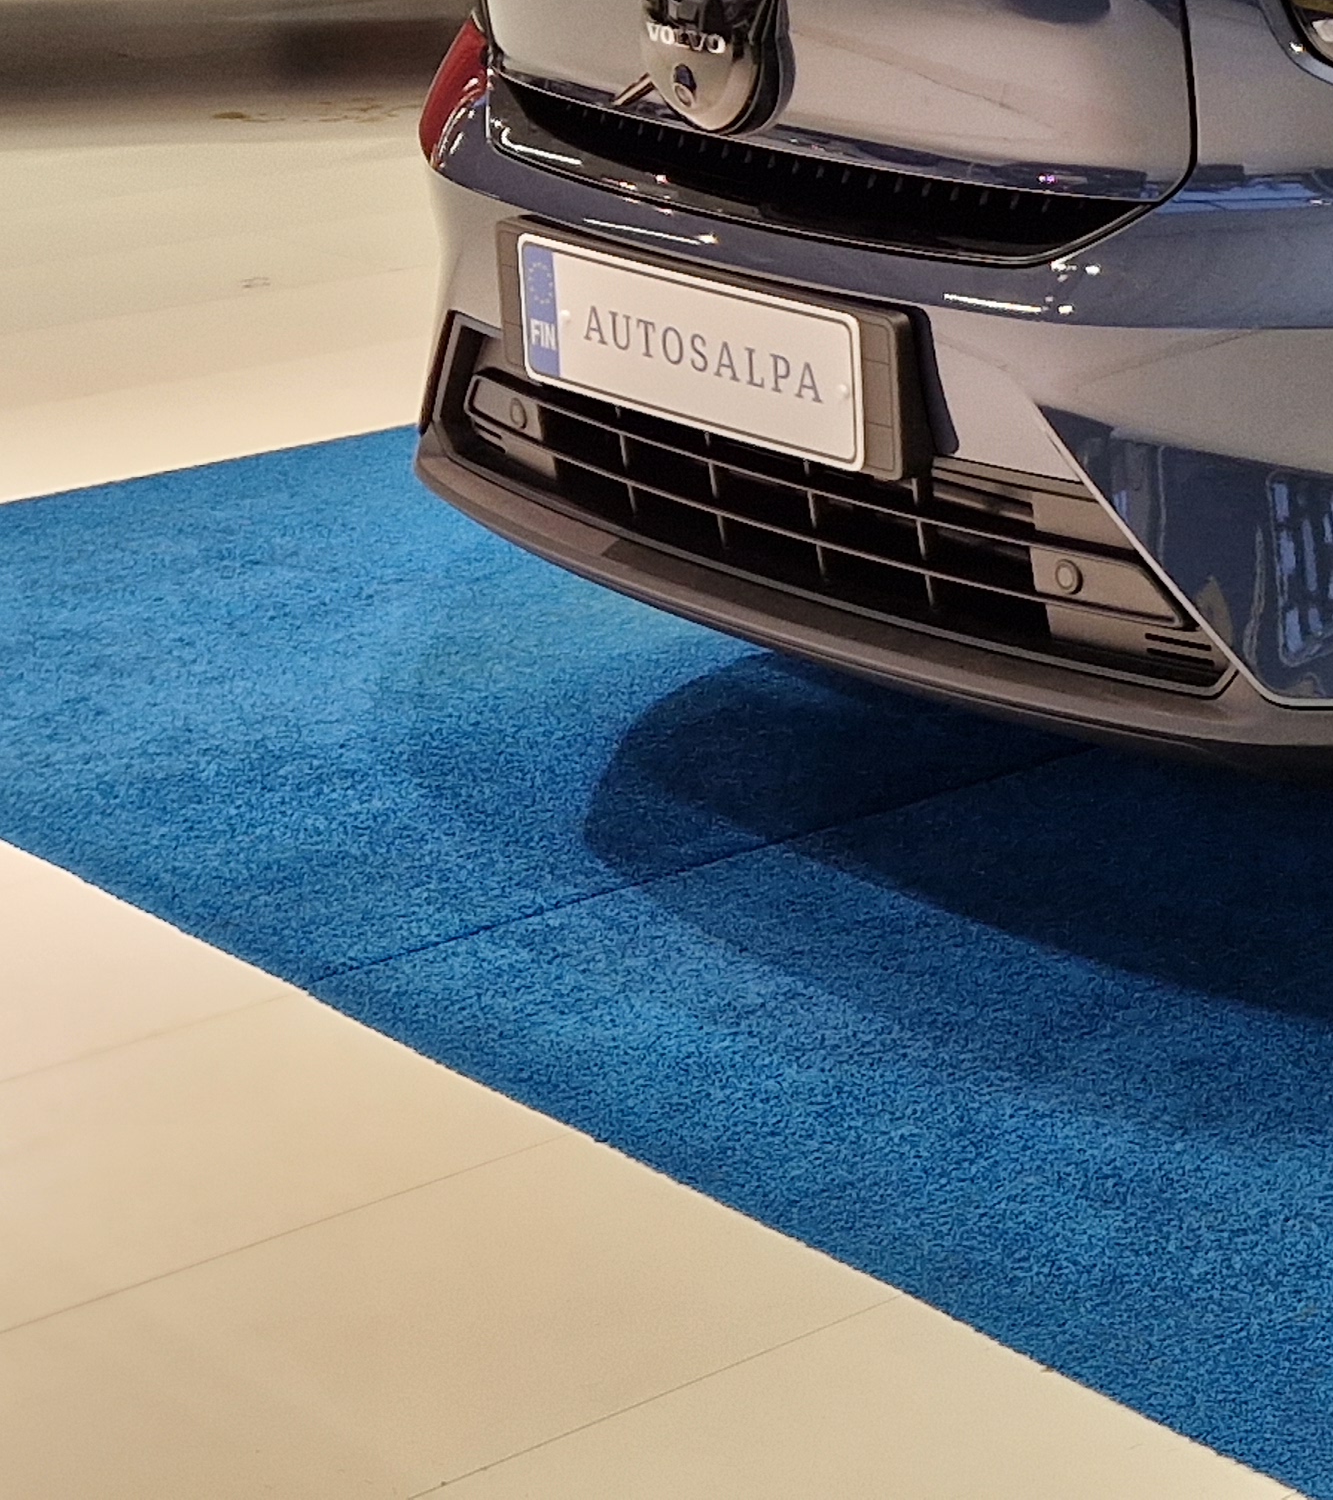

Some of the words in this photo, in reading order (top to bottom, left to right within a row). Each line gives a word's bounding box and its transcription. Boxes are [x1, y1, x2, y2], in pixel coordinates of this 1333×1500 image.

[646, 21, 726, 54] VOLVO
[529, 319, 557, 350] FIN
[583, 305, 823, 403] AUTOSALPA
